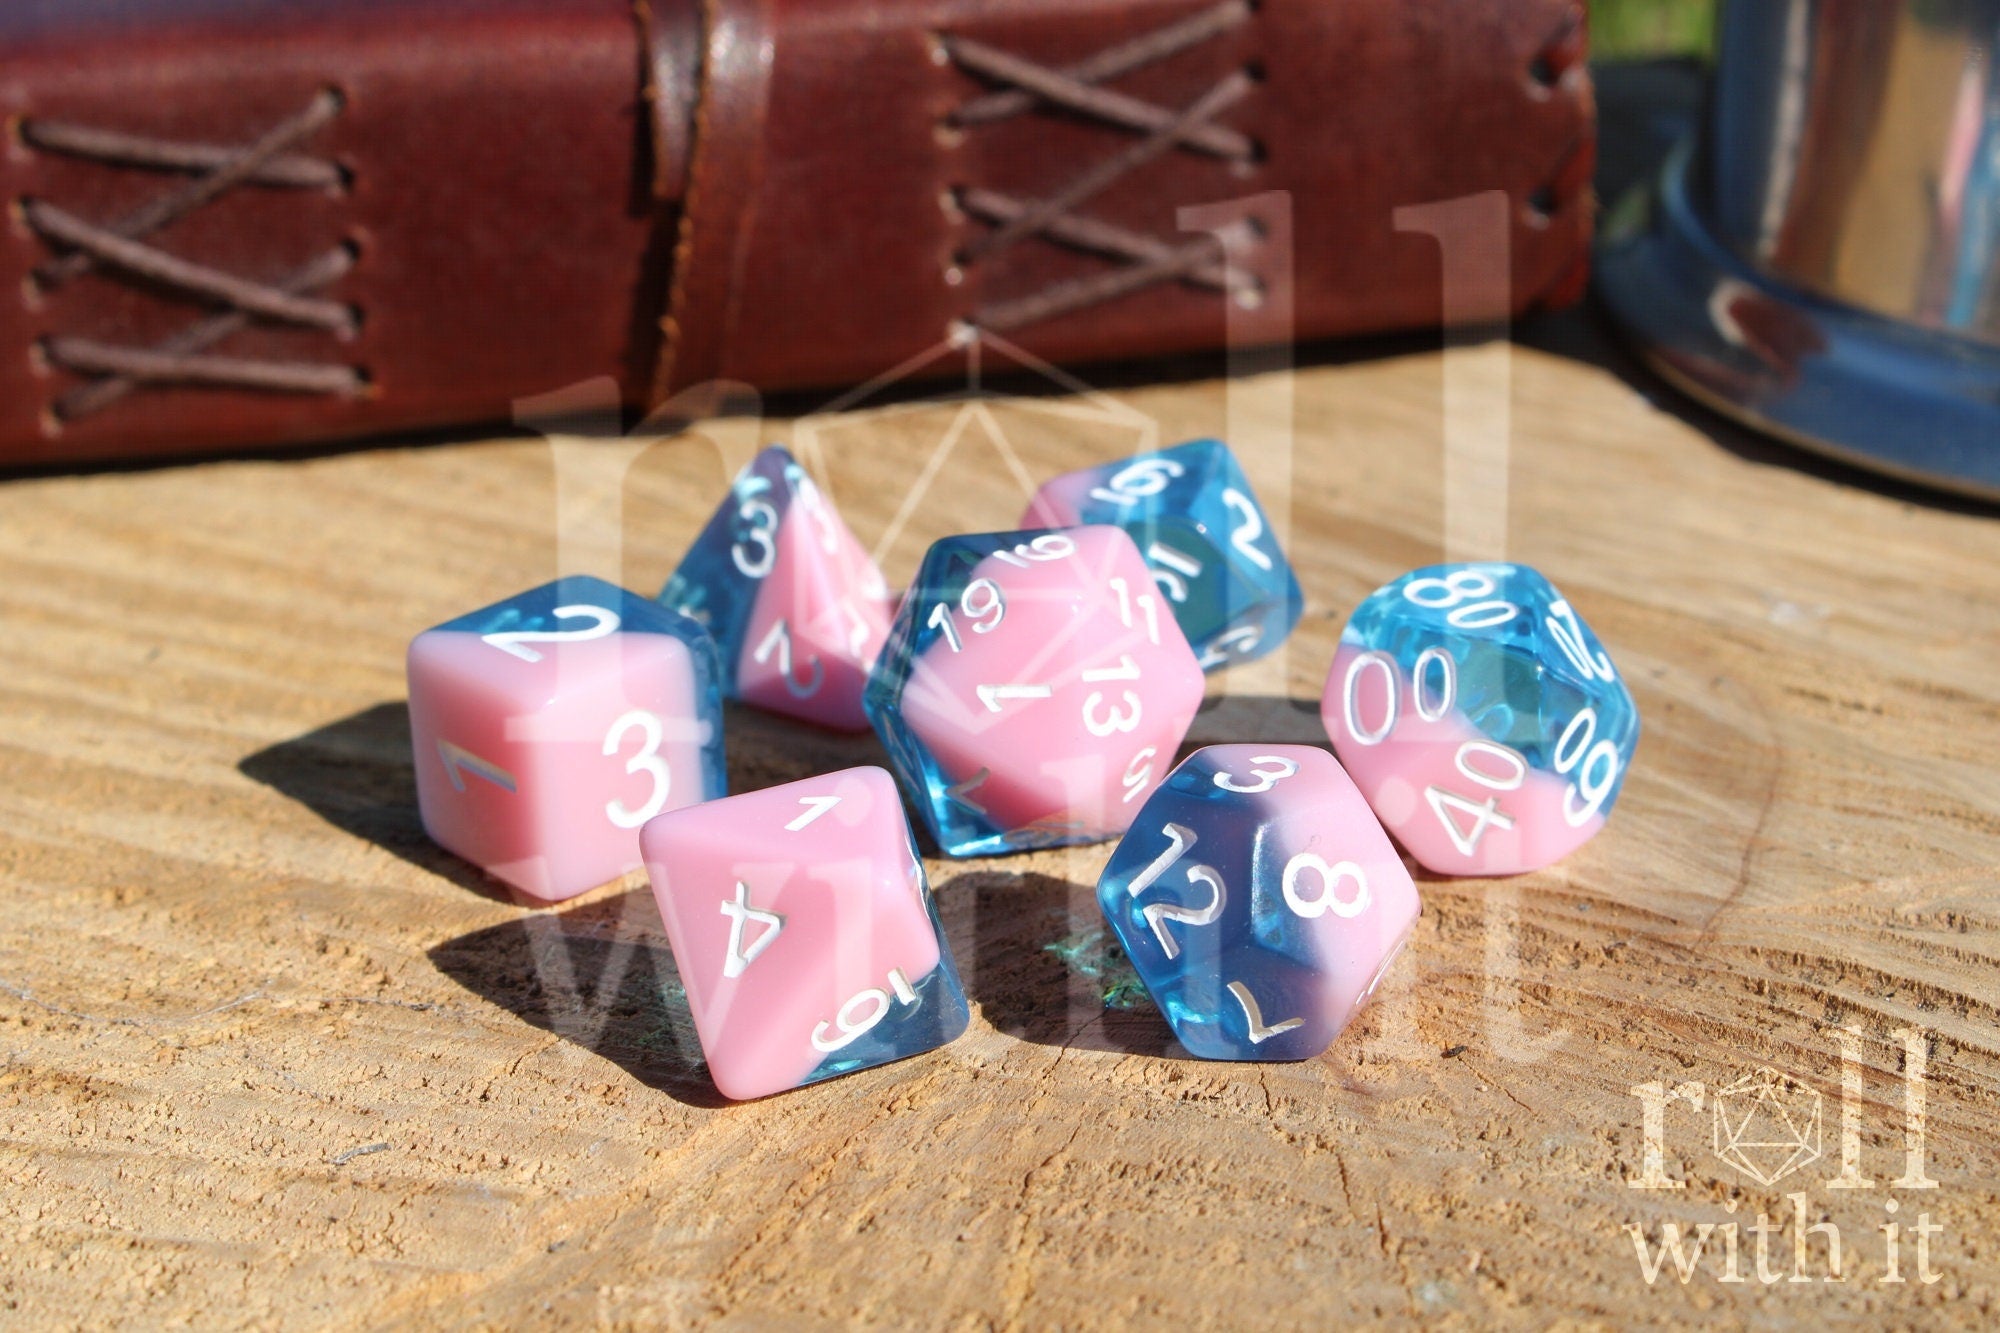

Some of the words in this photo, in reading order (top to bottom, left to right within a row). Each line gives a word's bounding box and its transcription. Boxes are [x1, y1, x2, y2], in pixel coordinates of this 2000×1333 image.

[731, 500, 779, 579] 3
[926, 576, 1007, 653] 19
[1403, 570, 1521, 629] 80
[1082, 655, 1142, 737] 13
[1343, 648, 1457, 746] 00
[602, 709, 672, 829] 3
[1213, 754, 1300, 794] 3
[1424, 738, 1530, 858] 40
[1126, 822, 1228, 960] 12
[1281, 852, 1372, 919] 8
[720, 880, 789, 979] 4
